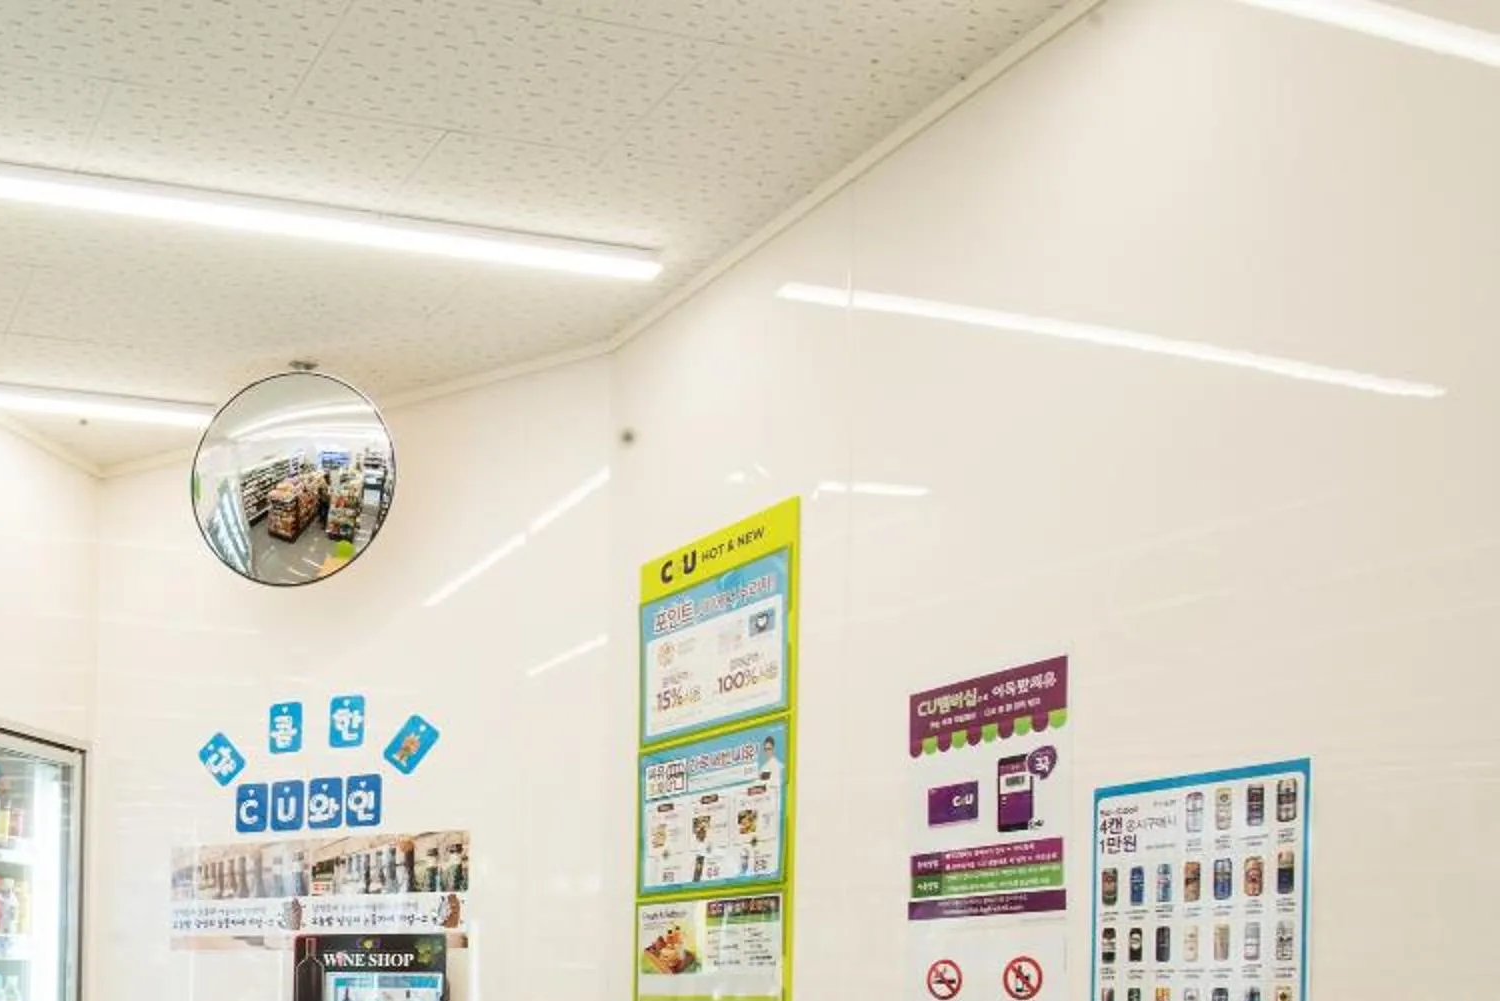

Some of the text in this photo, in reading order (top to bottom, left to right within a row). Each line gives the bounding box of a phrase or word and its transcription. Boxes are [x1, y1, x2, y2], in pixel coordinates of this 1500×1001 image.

[659, 549, 698, 584] CU
[700, 543, 726, 563] HOT
[735, 526, 766, 547] NEW
[368, 952, 416, 968] SHOP
